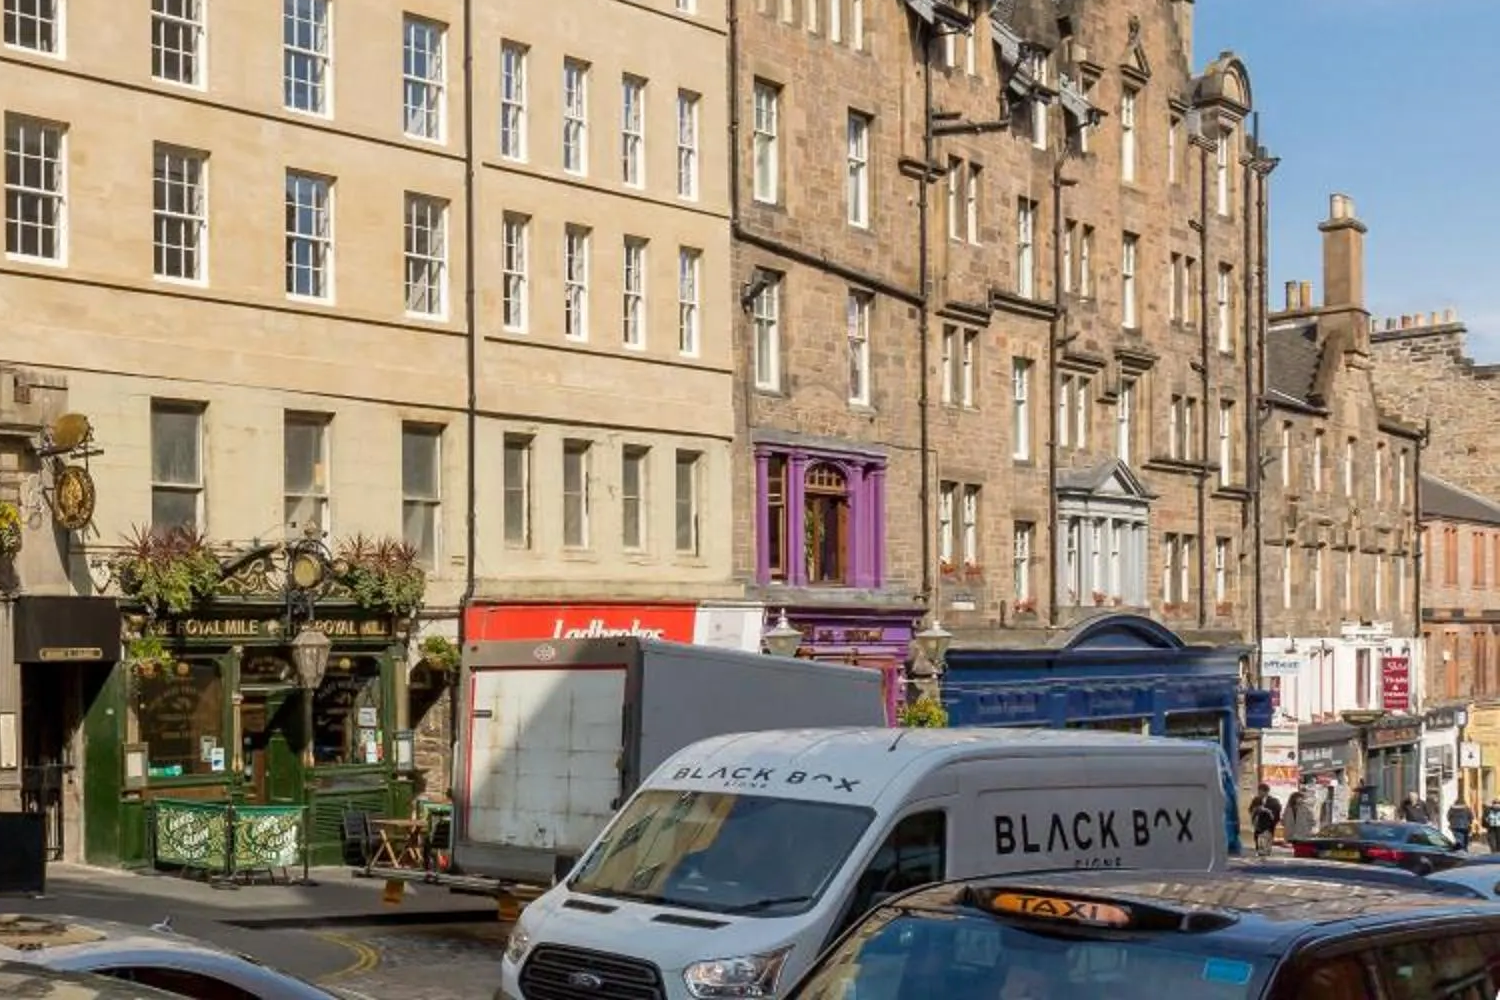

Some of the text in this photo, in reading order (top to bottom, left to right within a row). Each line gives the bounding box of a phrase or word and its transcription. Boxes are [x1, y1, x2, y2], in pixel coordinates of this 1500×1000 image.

[225, 619, 259, 635] MILE
[673, 766, 775, 782] BLACK
[995, 811, 1120, 854] BLACK
[1016, 897, 1099, 920] TAXI
